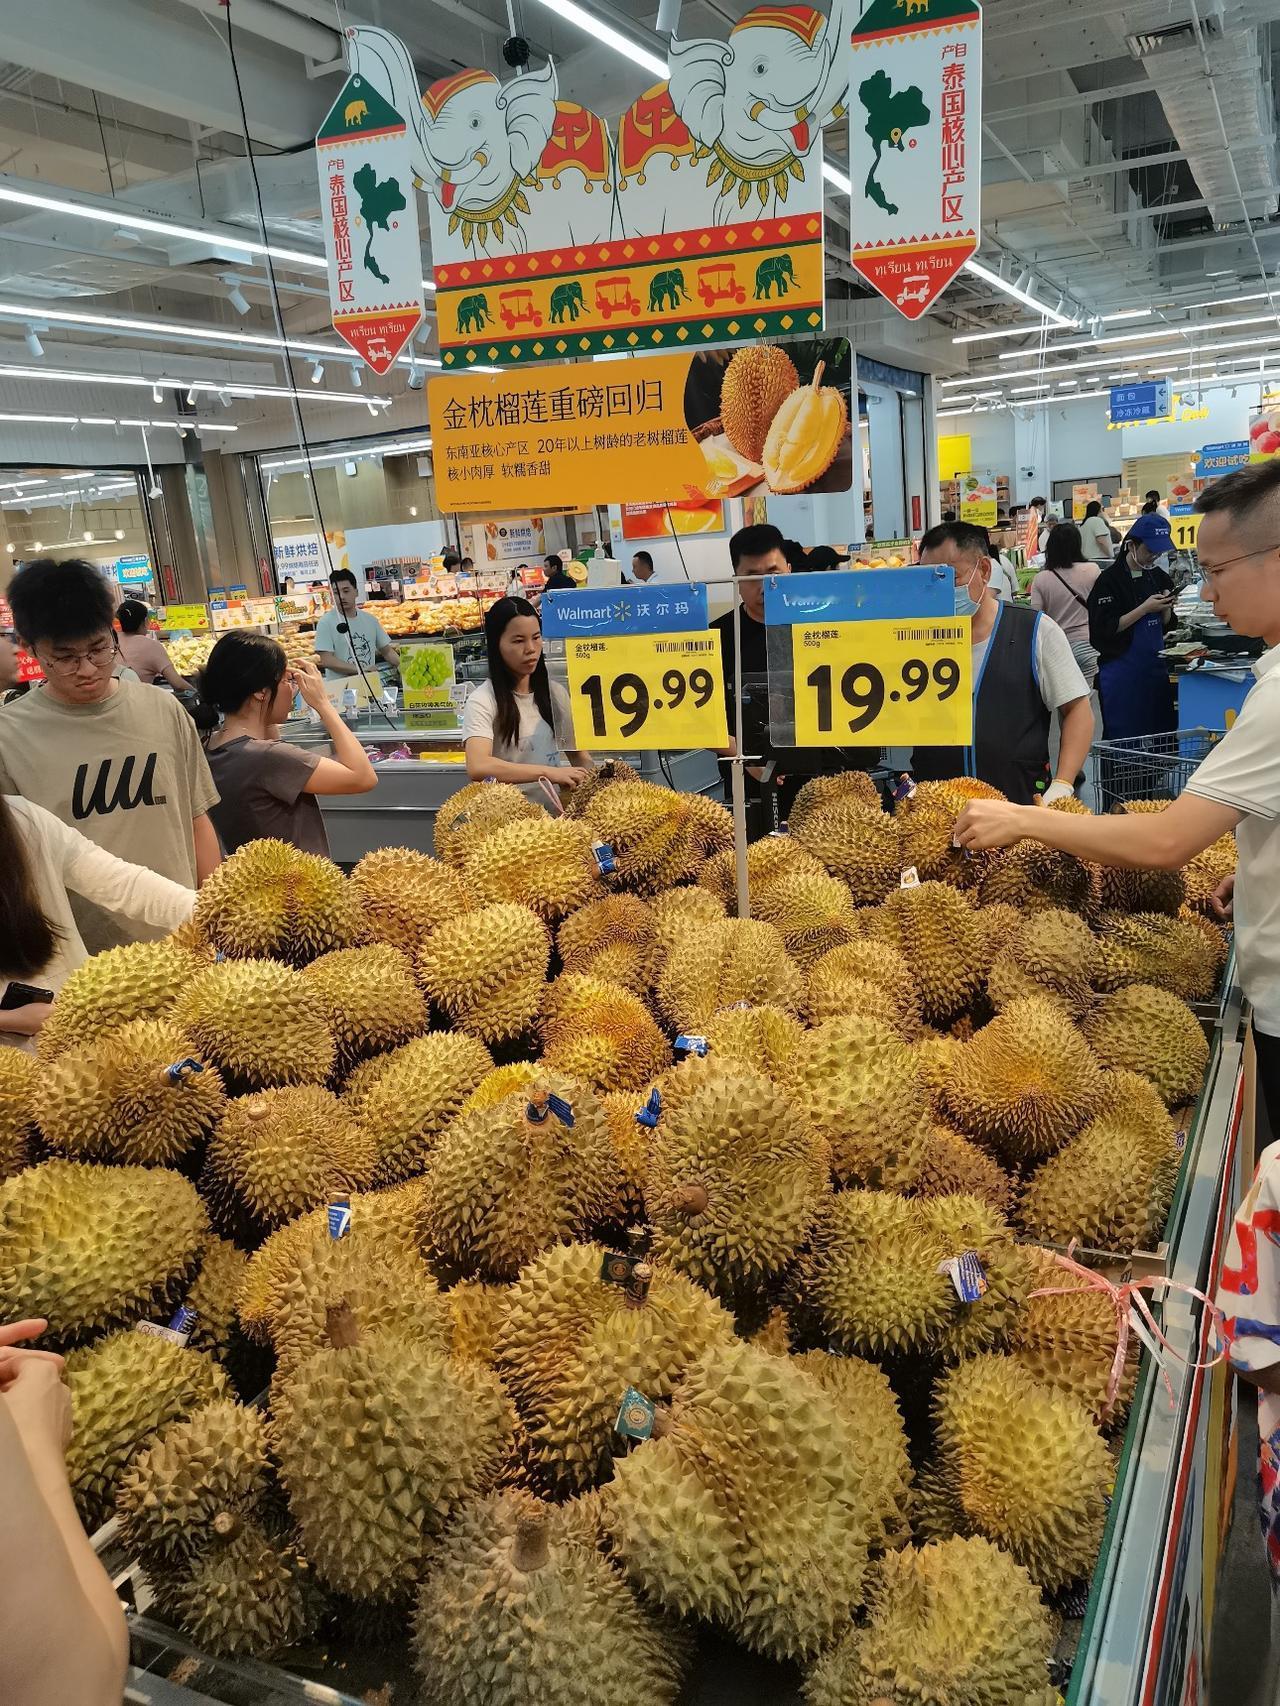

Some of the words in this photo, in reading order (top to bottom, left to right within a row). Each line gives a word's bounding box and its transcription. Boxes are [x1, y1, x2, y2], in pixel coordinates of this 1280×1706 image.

[941, 62, 966, 223] 泰国核心产区
[329, 174, 355, 302] 泰国核心产区
[442, 379, 663, 431] 金枕榴莲重磅回归
[445, 440, 530, 461] 东南亚核心产区
[537, 428, 688, 454] 20年以上树龄的老树榴莲
[447, 464, 495, 481] 核小肉厚
[501, 460, 551, 478] 软糯香甜
[274, 542, 318, 560] 新鲜烘焙
[557, 606, 612, 621] Walmart
[636, 601, 690, 617] 沃尔玛
[803, 640, 821, 648] 500g
[581, 668, 714, 738] 19.99
[807, 658, 960, 734] 19.99
